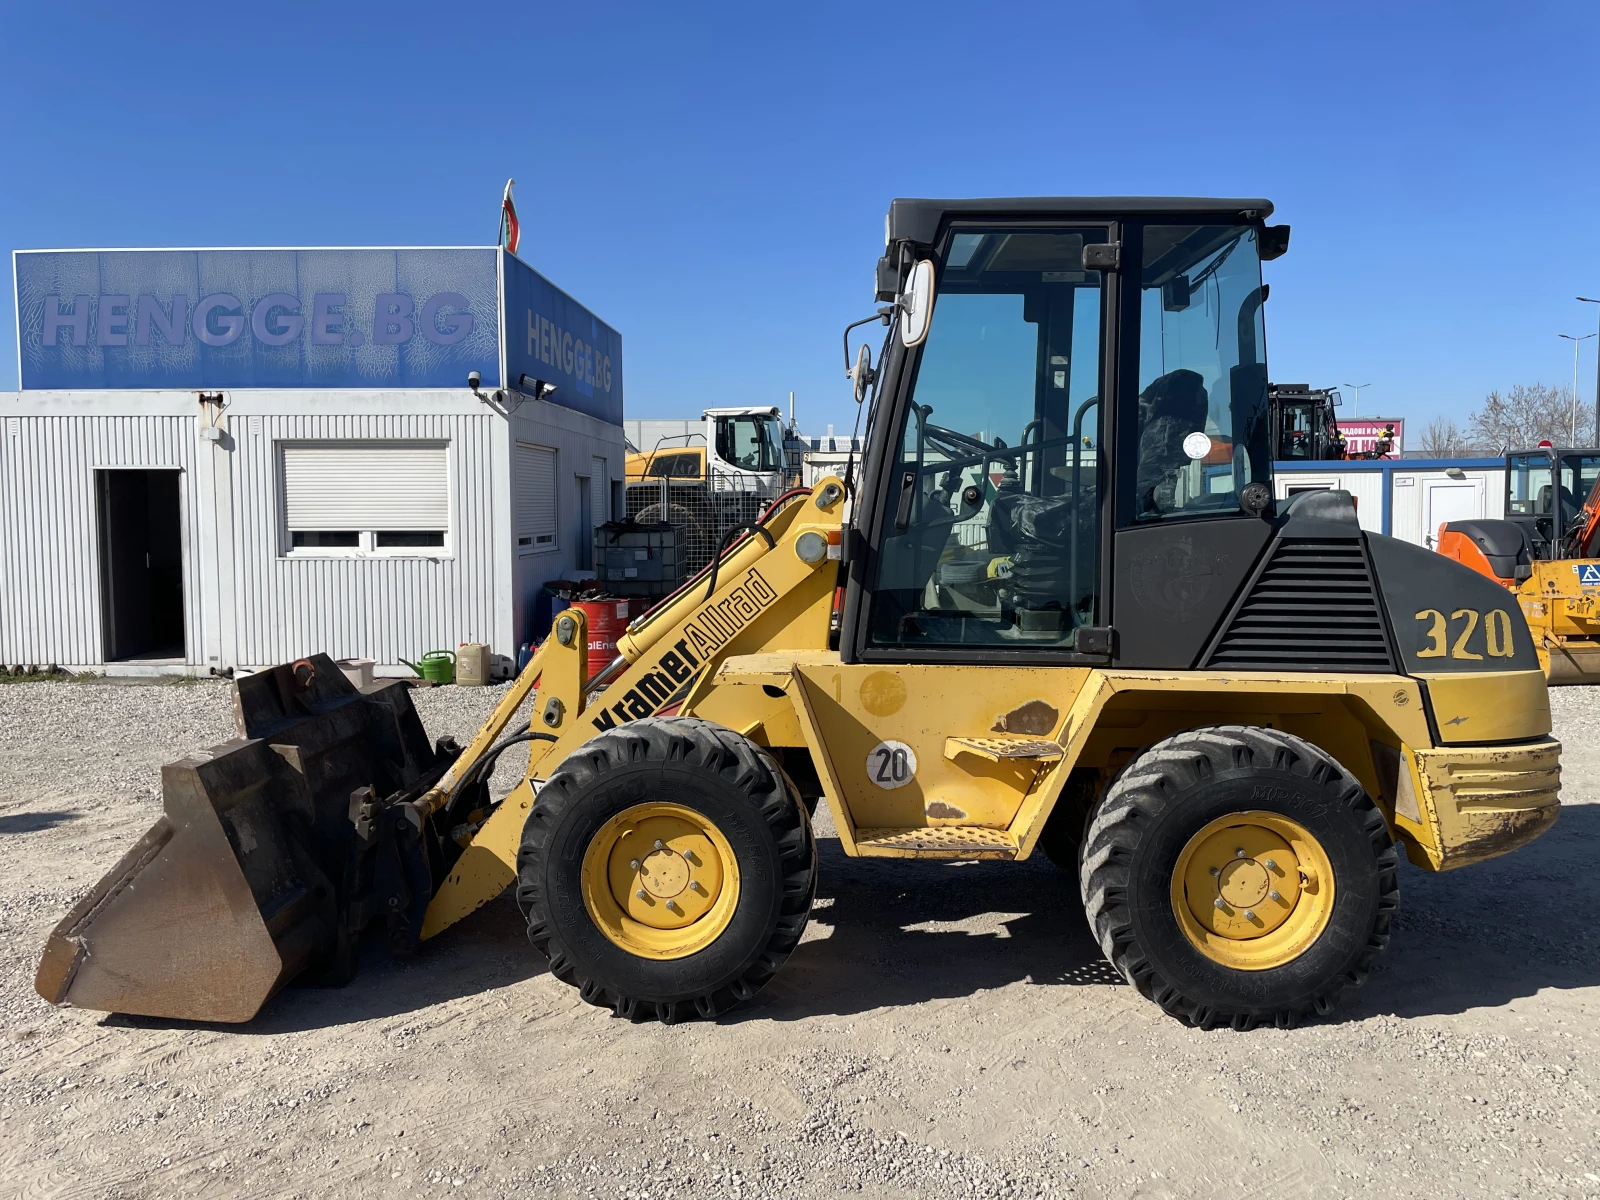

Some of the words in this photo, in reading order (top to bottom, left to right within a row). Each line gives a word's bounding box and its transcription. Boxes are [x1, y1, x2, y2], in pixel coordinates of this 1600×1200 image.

[42, 291, 475, 347] HENGGE.BG
[526, 308, 613, 394] HENGGE.BG
[592, 638, 700, 731] Kramer
[684, 567, 778, 660] Allrad
[1414, 608, 1515, 661] 320
[875, 748, 908, 783] 20
[1250, 785, 1289, 802] MP
[1288, 793, 1328, 819] 567
[745, 844, 767, 882] 567
